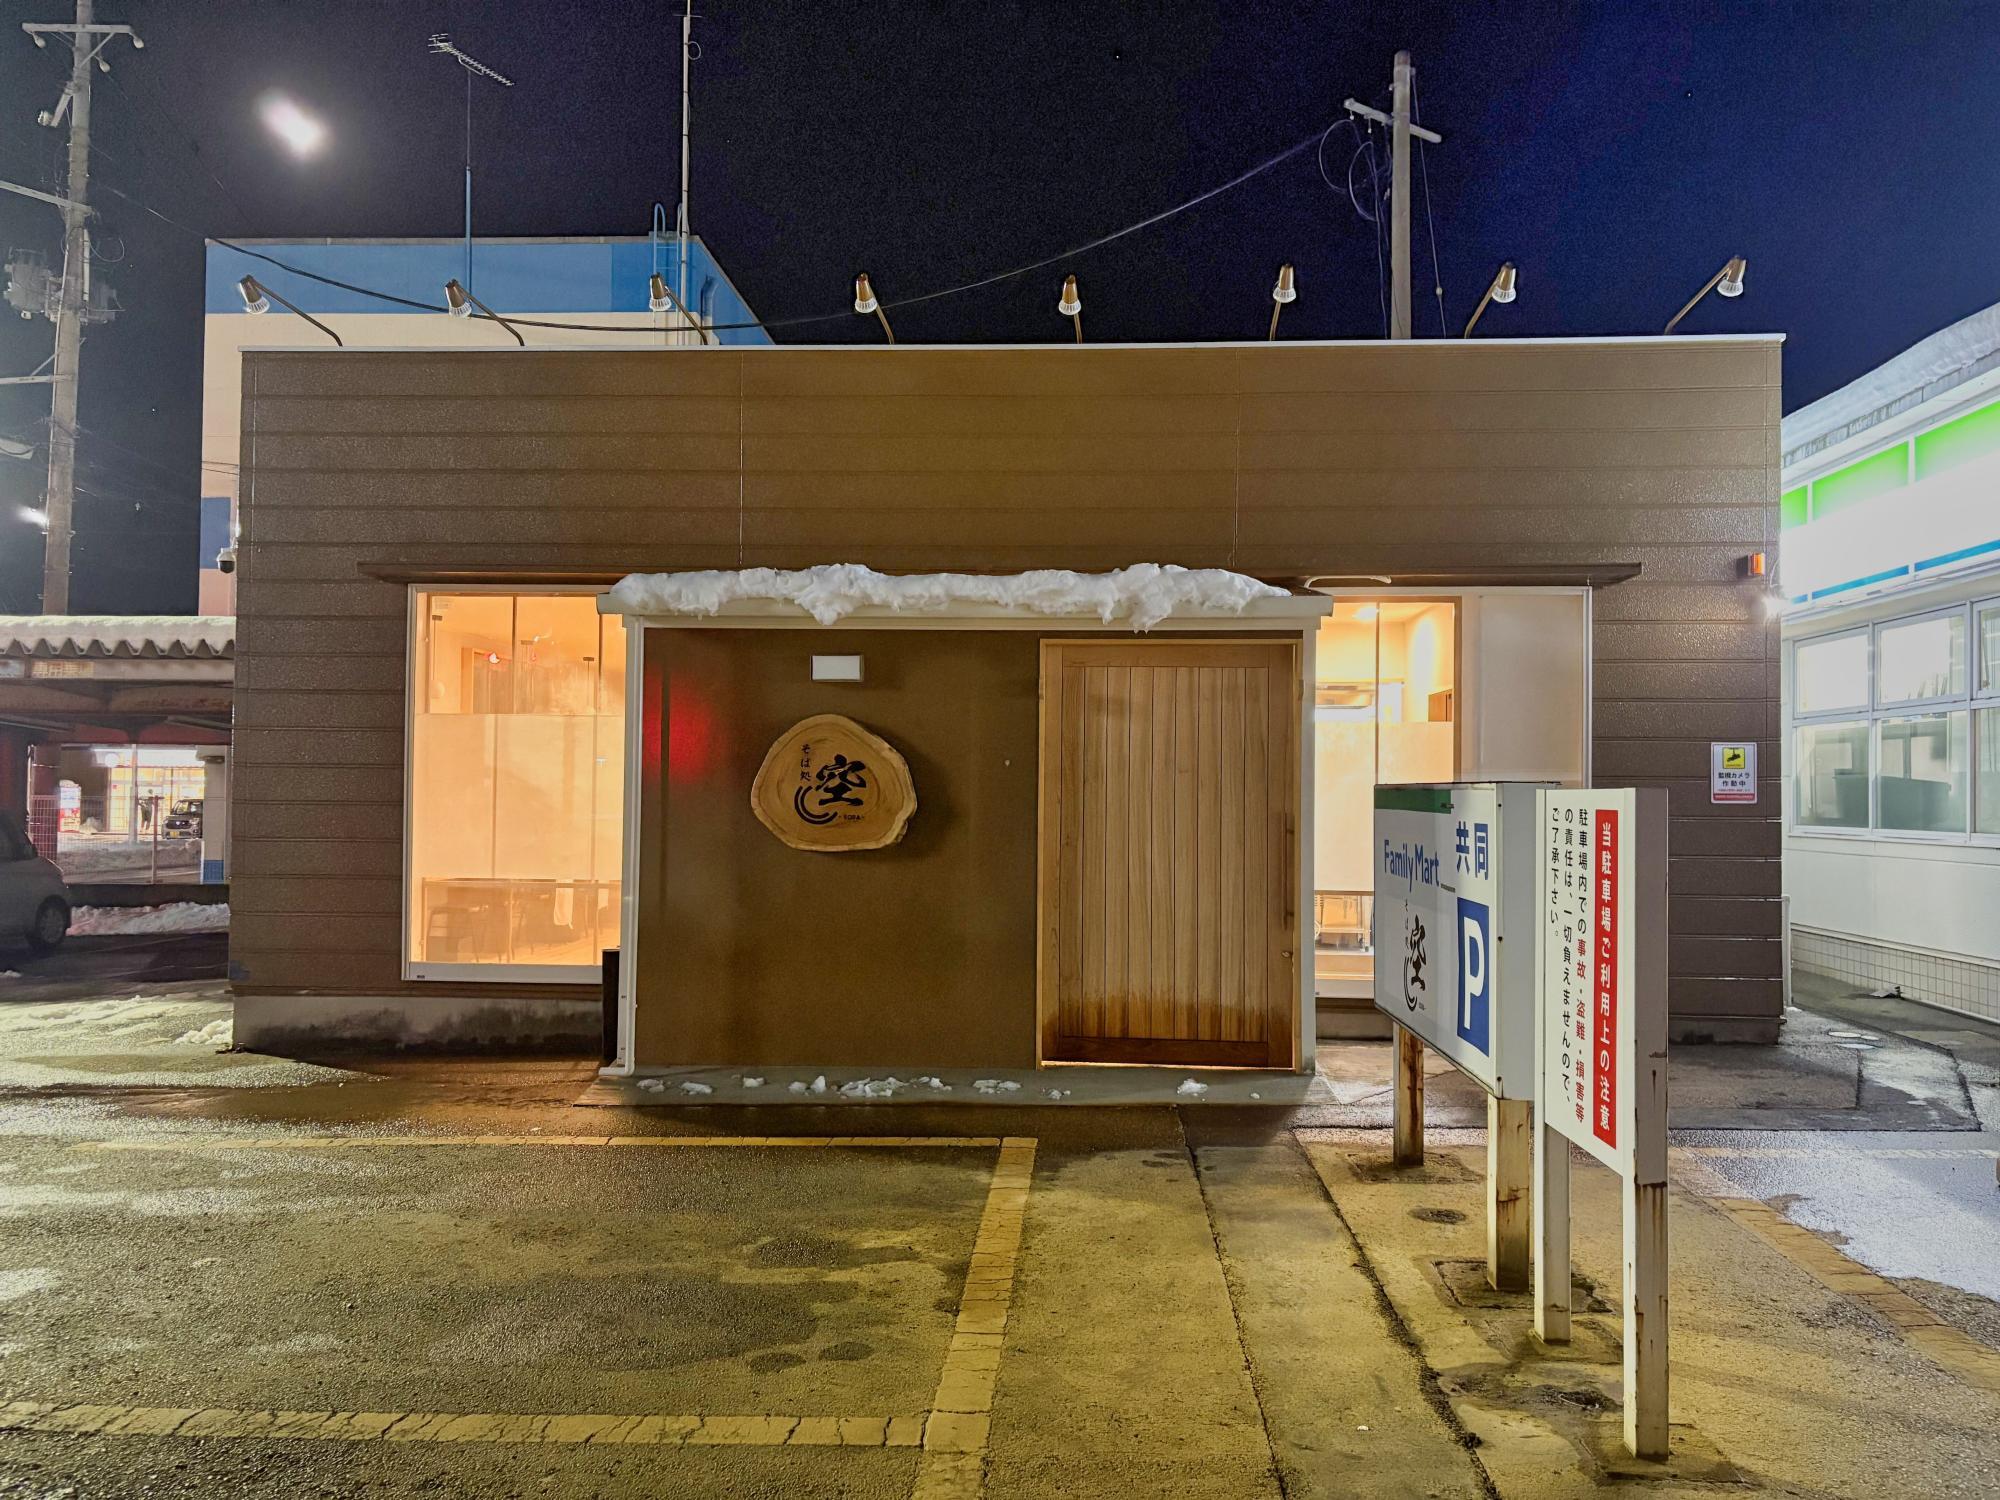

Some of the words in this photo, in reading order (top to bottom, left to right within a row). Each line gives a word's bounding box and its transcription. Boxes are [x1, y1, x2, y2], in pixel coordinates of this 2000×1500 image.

[801, 744, 811, 781] そば処
[1456, 821, 1489, 880] 共同
[1551, 807, 1560, 936] ご了承下さい。
[1463, 916, 1485, 1030] P
[1562, 808, 1574, 1102] の責任は、一切負えませんので、
[1600, 822, 1612, 1131] 当駐車場ご利用上の注意
